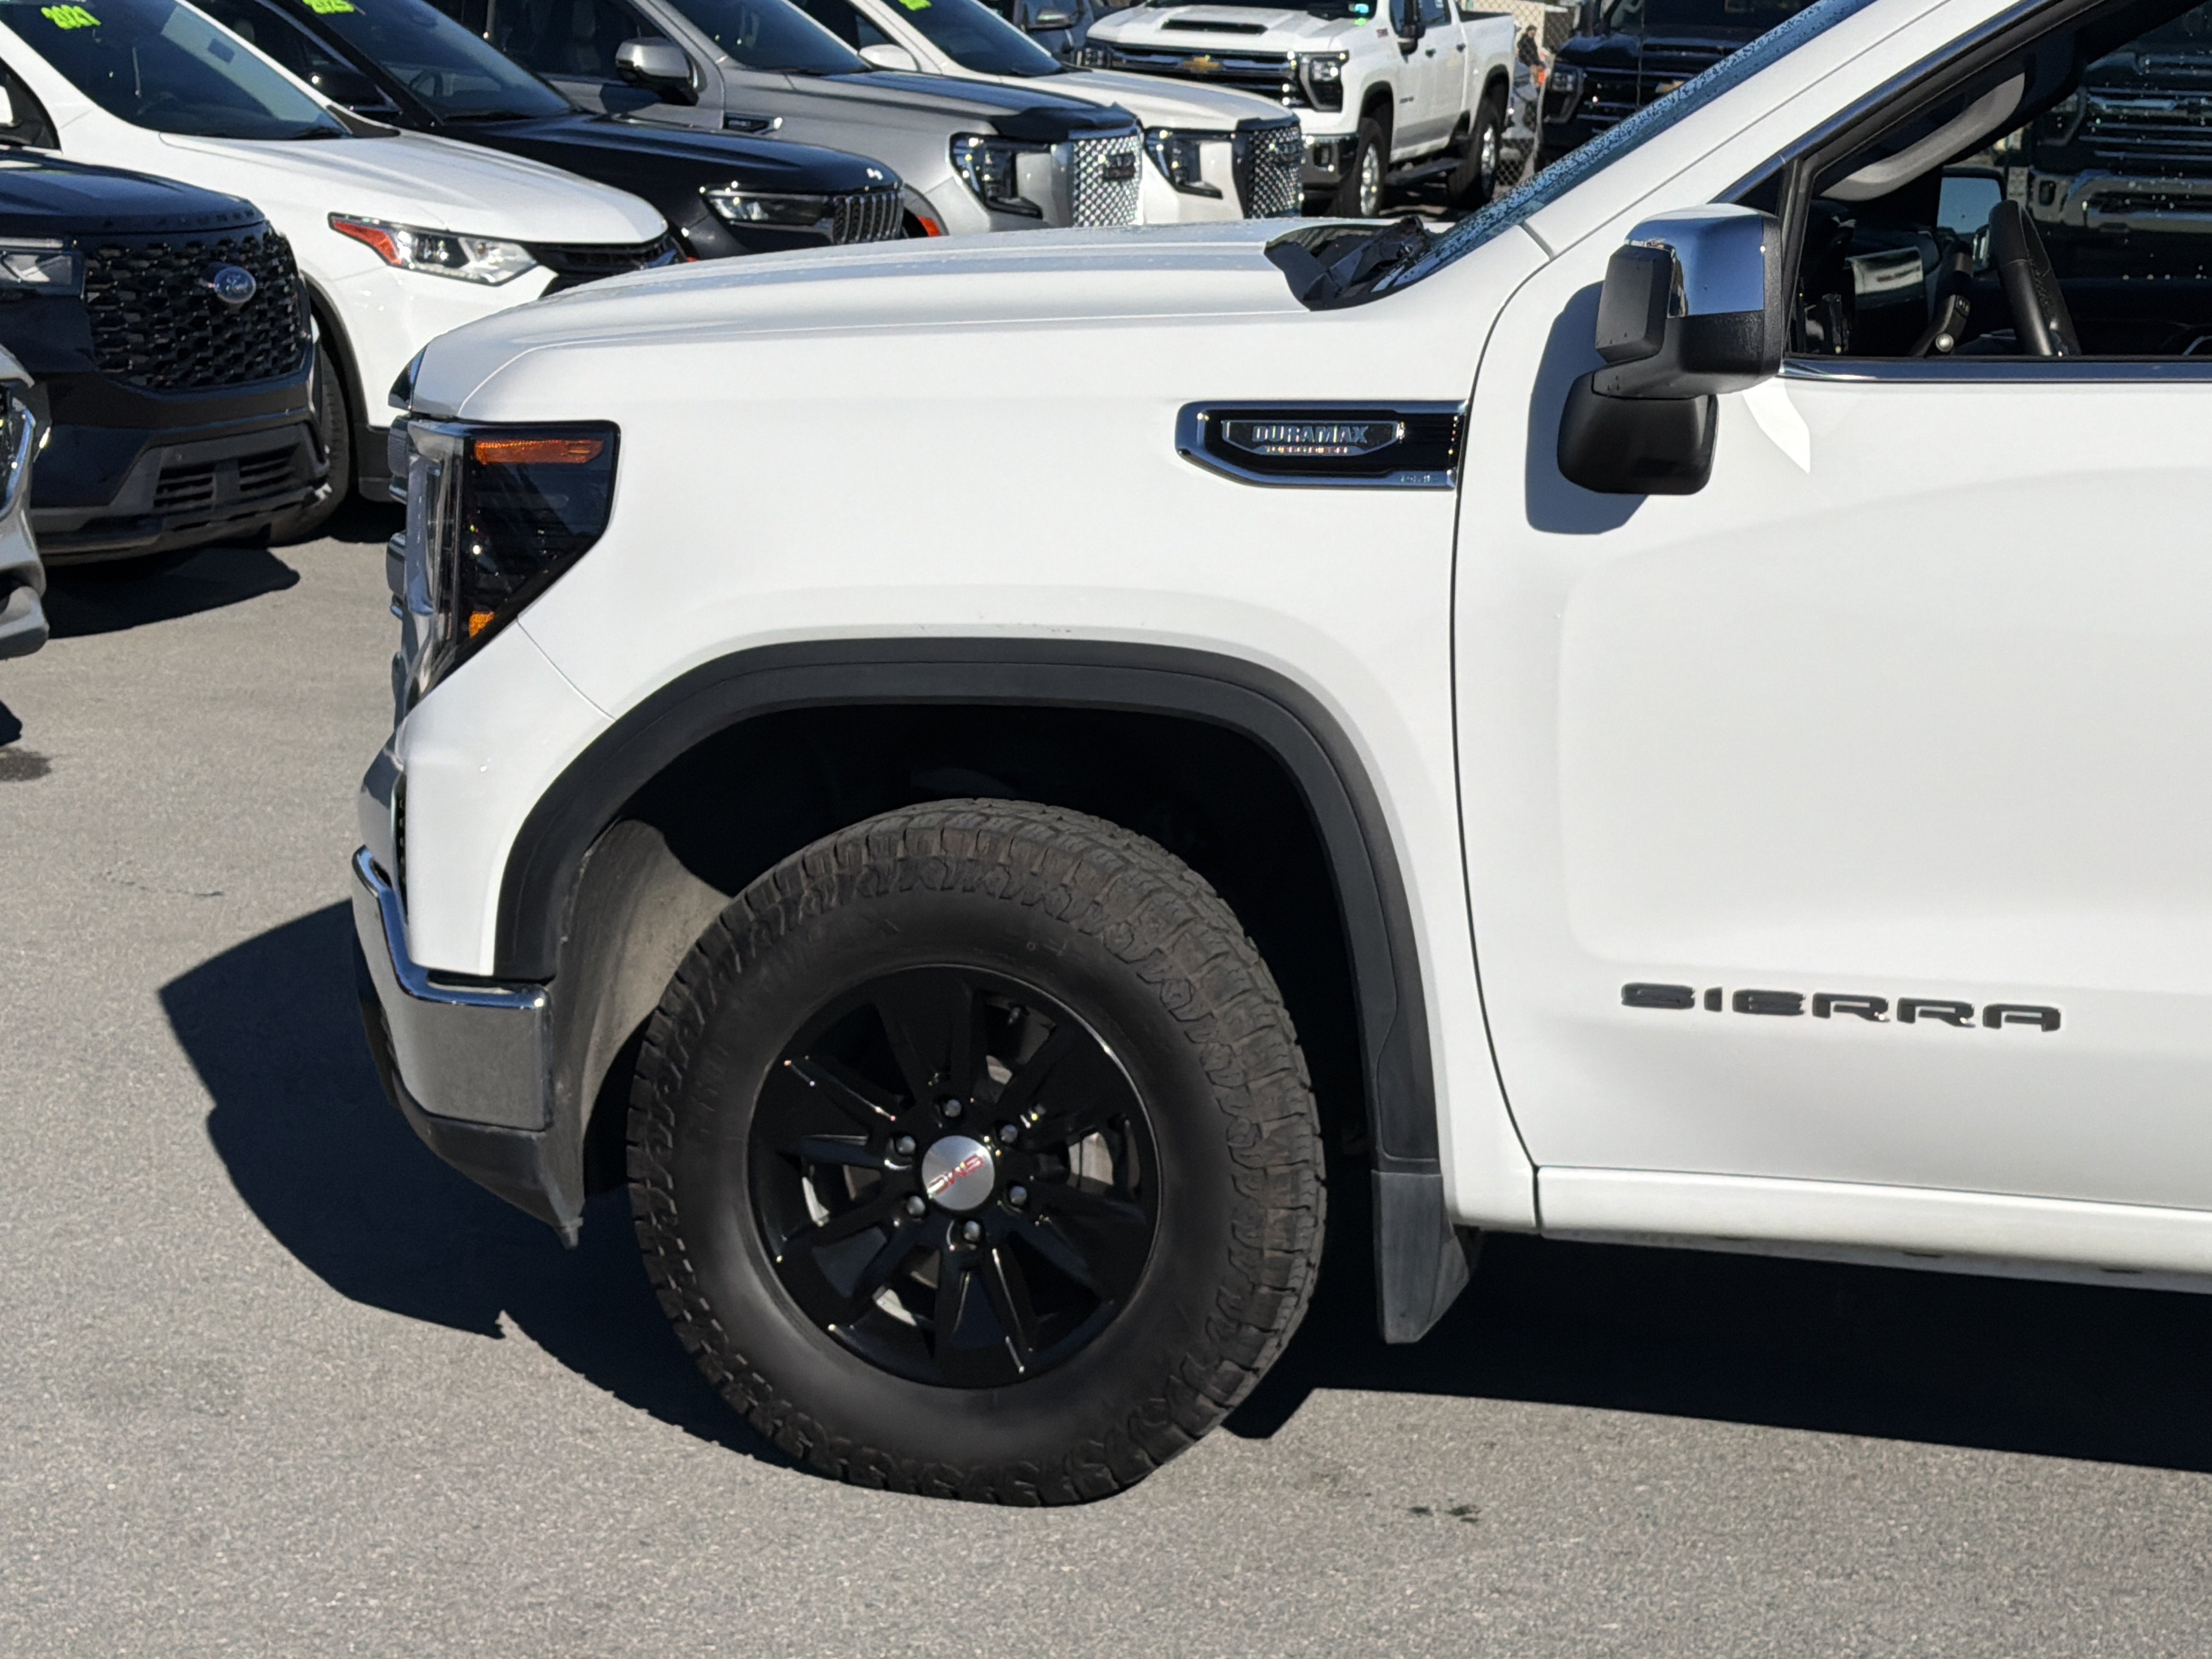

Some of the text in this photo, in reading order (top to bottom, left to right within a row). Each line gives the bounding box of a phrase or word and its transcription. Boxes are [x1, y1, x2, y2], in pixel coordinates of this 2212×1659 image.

[1252, 425, 1368, 444] DURAMAX
[1622, 983, 2062, 1032] SIERRA
[927, 1154, 984, 1195] GMC
